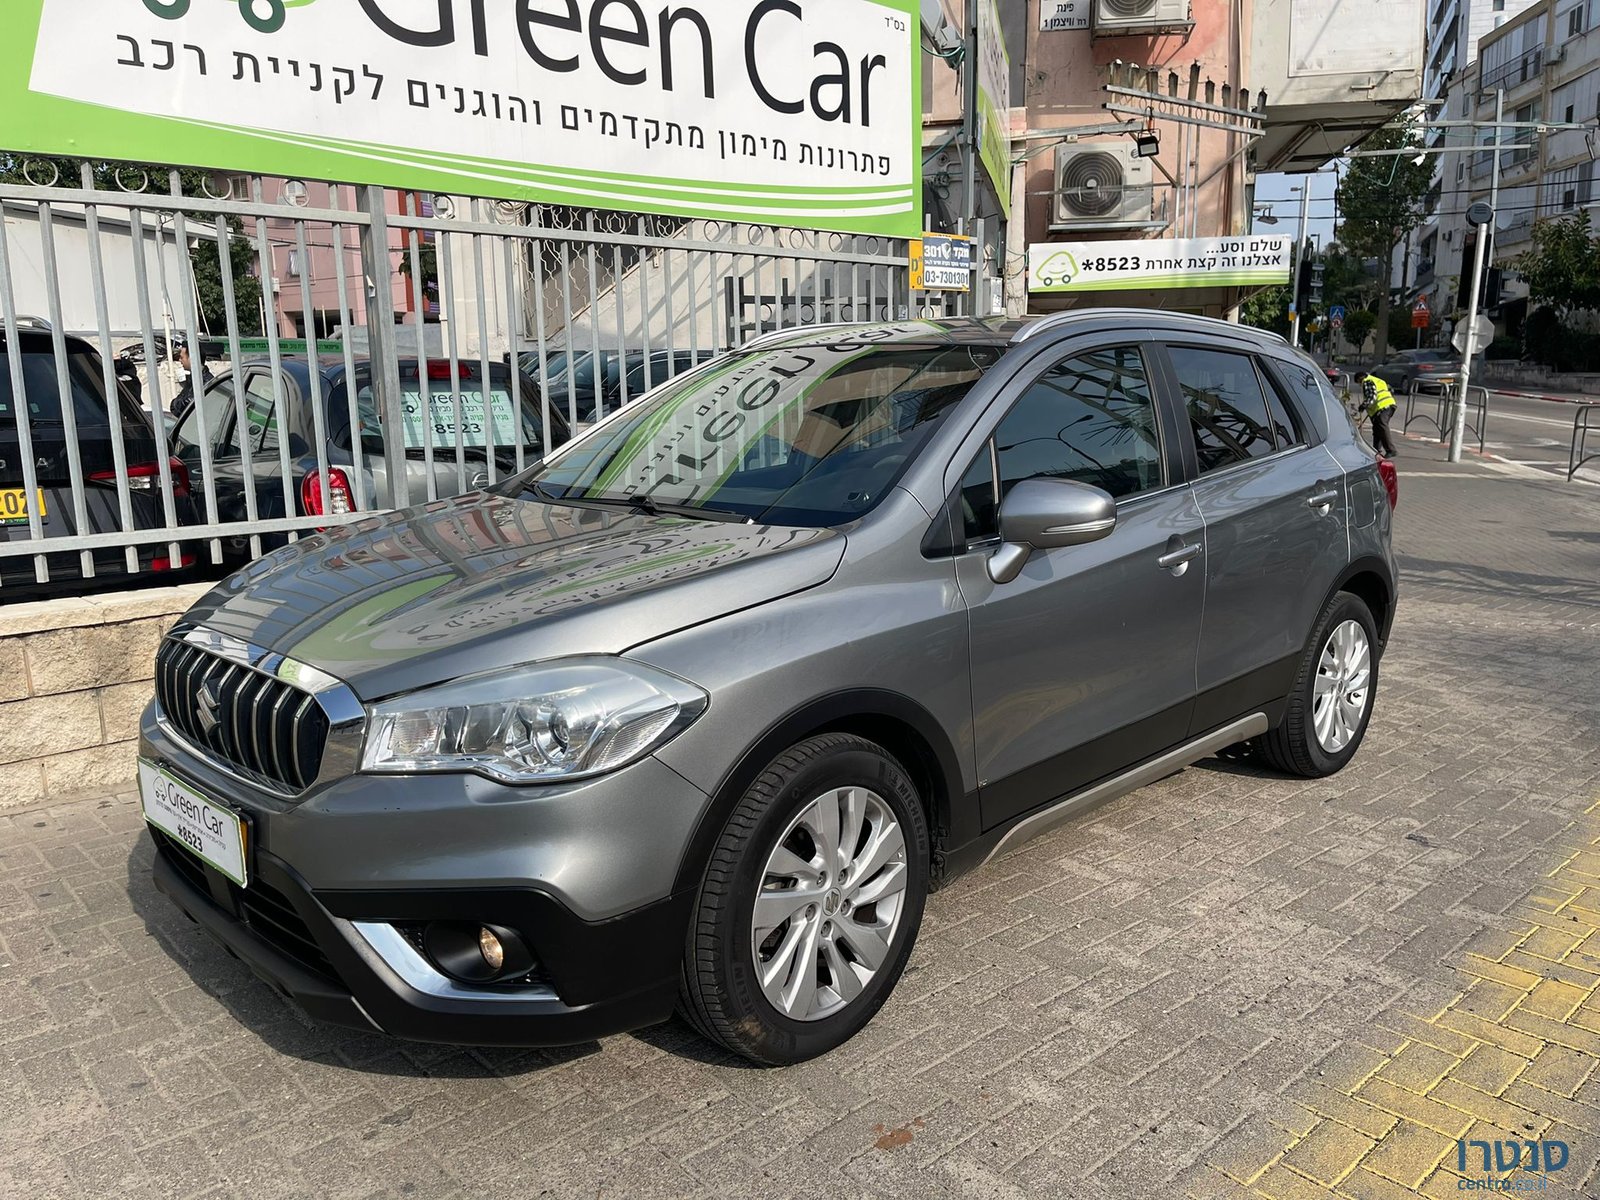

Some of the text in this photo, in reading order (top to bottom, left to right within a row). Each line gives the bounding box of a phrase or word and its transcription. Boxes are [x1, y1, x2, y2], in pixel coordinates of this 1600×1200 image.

[1056, 3, 1075, 13] פינת
[744, 0, 886, 127] Car
[117, 34, 891, 176] פתרונות מימון מתקדמים והוגנים לקניית רכב
[1250, 239, 1282, 252] שלם
[1145, 258, 1183, 271] אחרת
[1187, 257, 1218, 271] קצת
[1221, 256, 1238, 268] זה
[1242, 253, 1282, 267] אצלנו
[431, 423, 482, 435] 8523
[167, 782, 201, 824] Green
[202, 805, 224, 838] Car
[897, 782, 927, 851] MICHELIN
